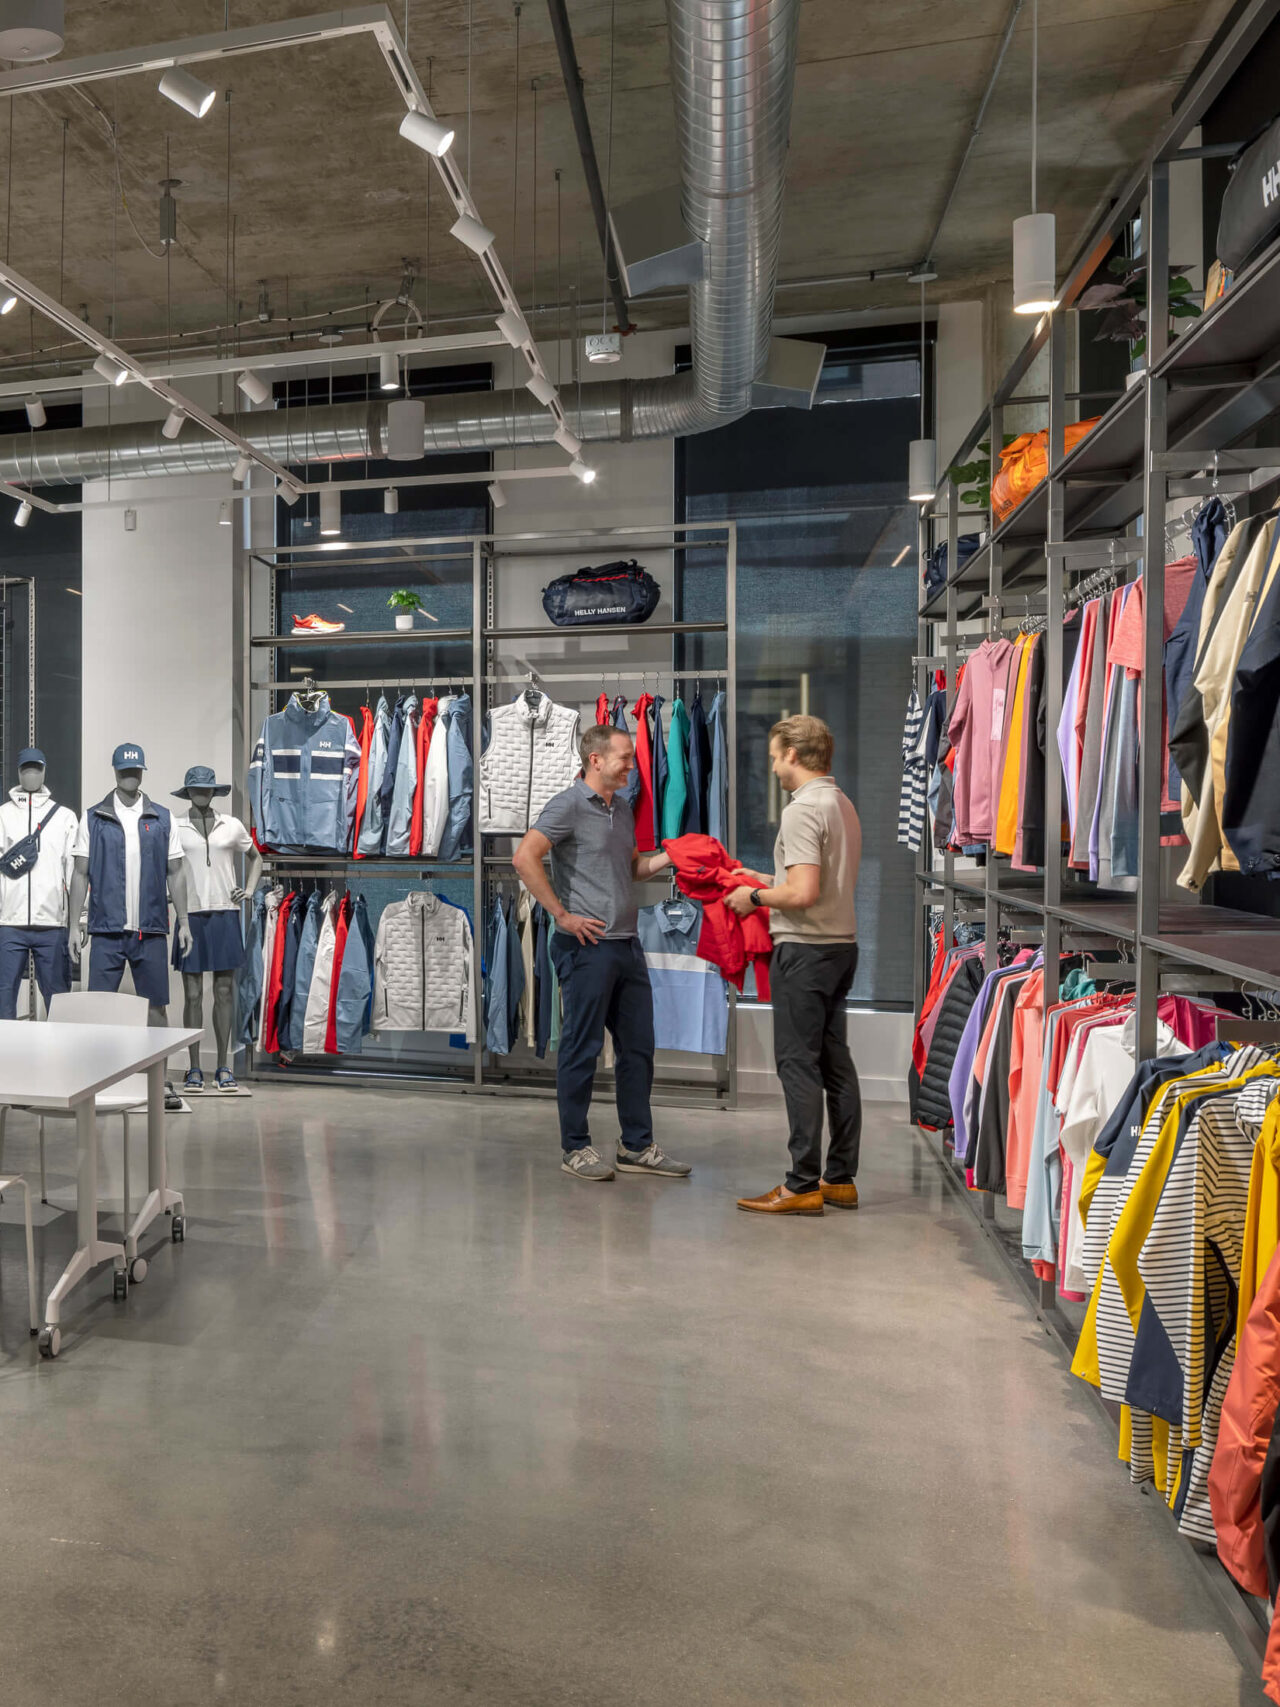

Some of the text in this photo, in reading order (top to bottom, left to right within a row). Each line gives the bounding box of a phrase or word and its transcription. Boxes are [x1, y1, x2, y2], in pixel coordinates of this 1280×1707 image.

[574, 606, 626, 617] HELLY HANSEN
[318, 741, 331, 749] HH
[123, 751, 138, 759] HH
[10, 854, 27, 870] HH
